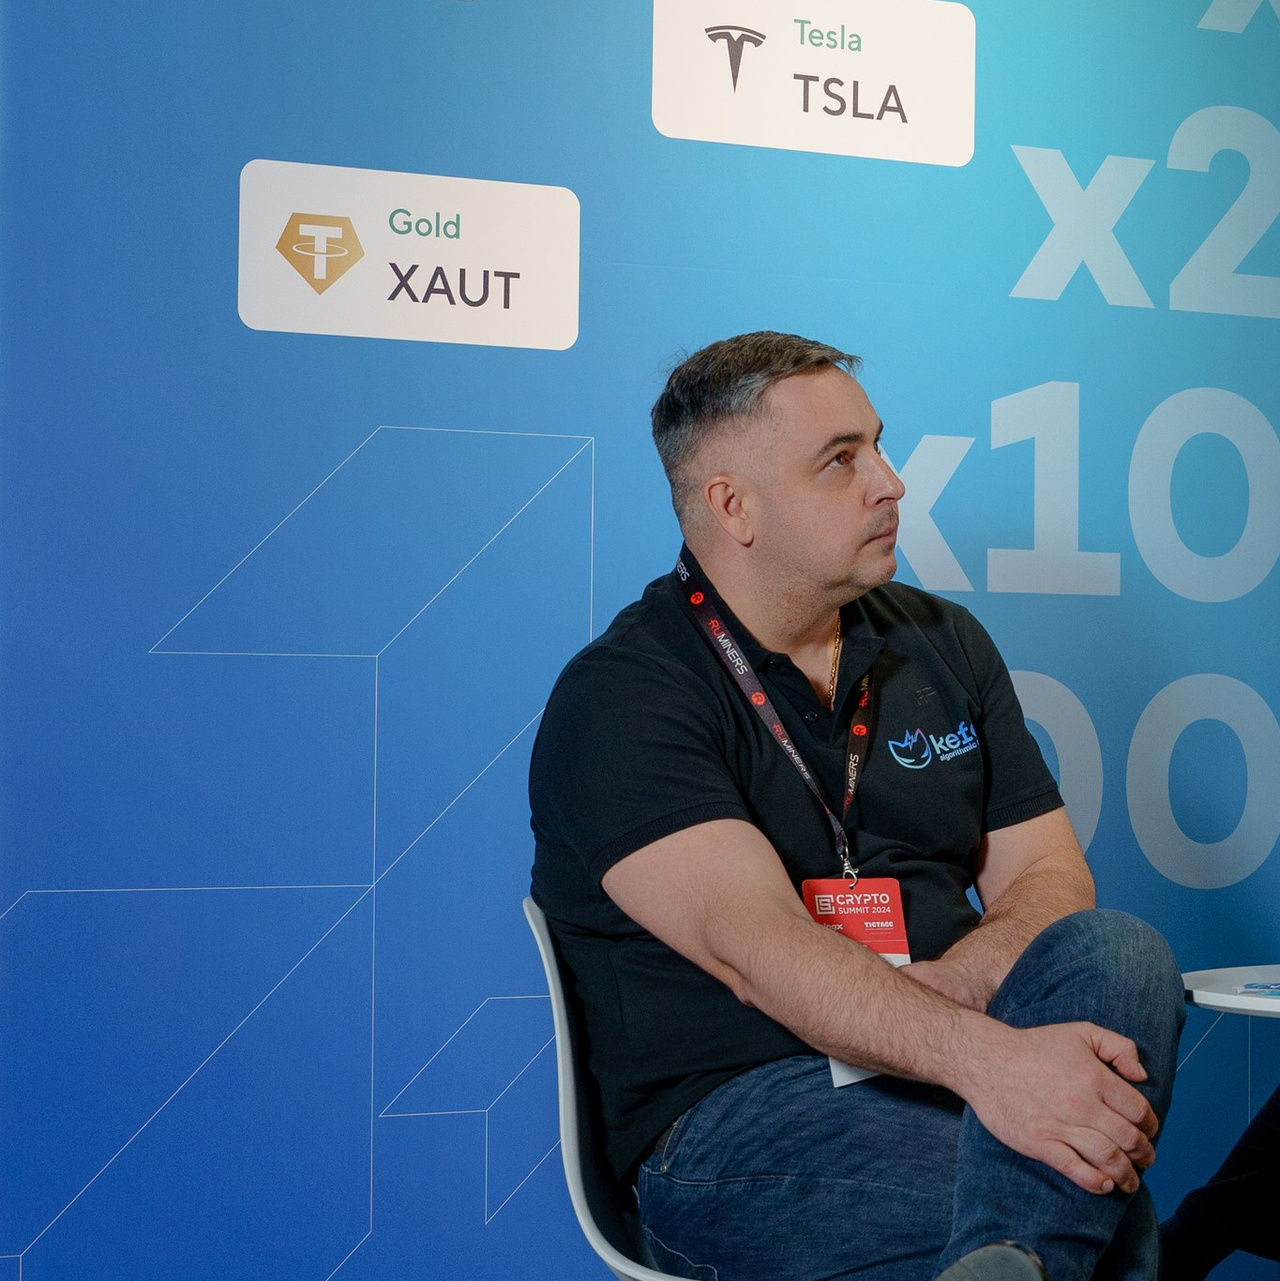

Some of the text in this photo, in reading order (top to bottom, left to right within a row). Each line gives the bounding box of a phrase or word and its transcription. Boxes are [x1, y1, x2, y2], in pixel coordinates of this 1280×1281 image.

[793, 18, 863, 53] Tesla
[793, 72, 909, 124] TSLA
[388, 207, 462, 240] Gold
[386, 262, 521, 310] XAUT
[709, 618, 749, 676] RUMINERS
[772, 722, 812, 781] RUMINERS
[836, 893, 890, 905] CRYPTO
[838, 906, 892, 915] SUMMIT 2024
